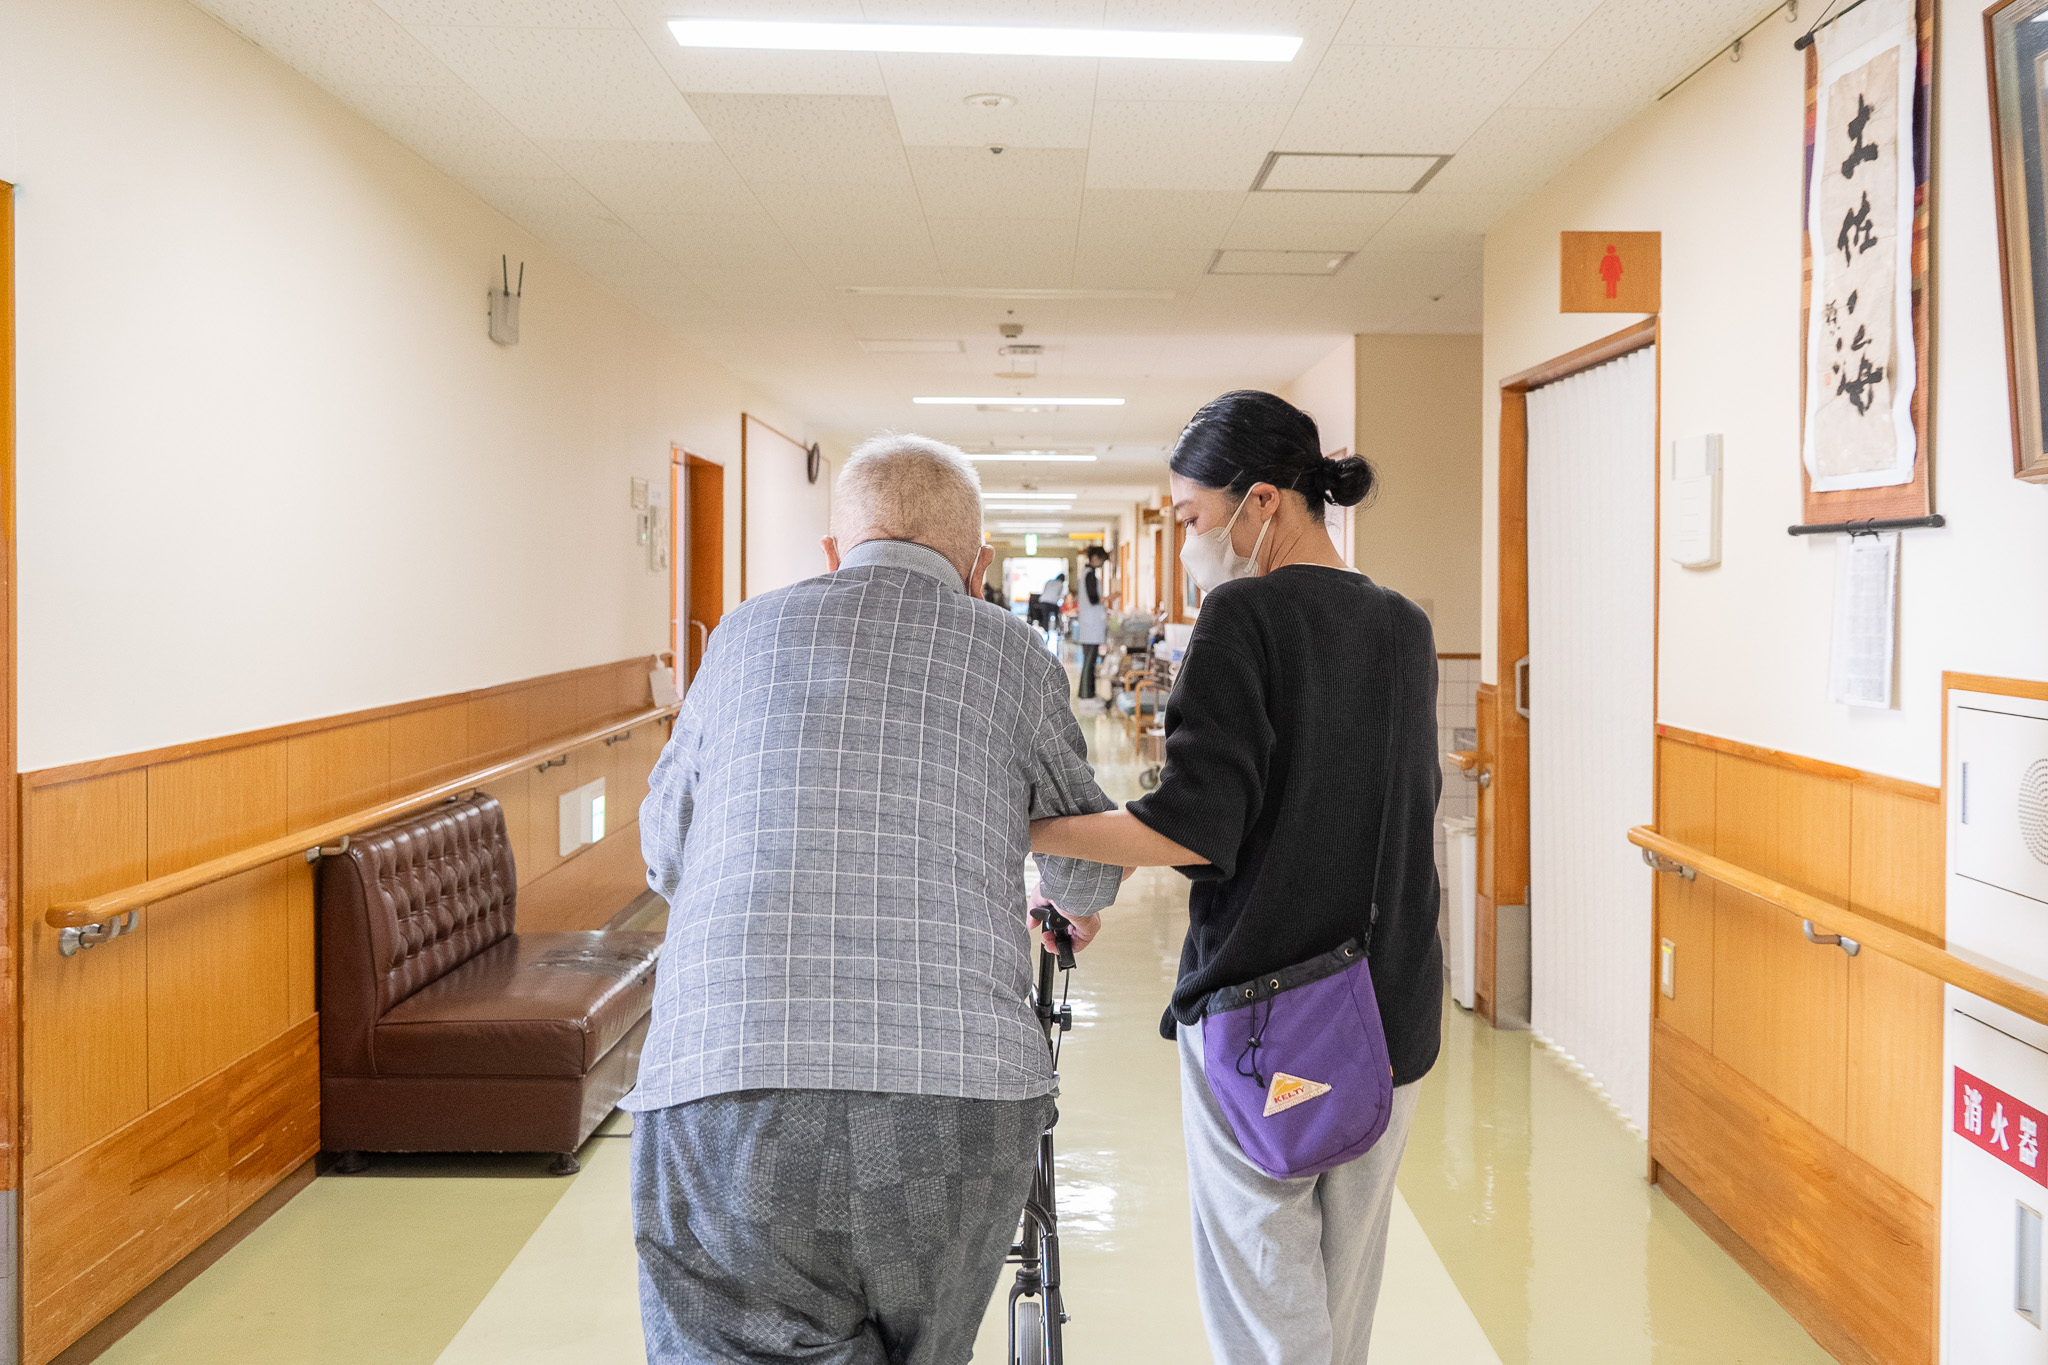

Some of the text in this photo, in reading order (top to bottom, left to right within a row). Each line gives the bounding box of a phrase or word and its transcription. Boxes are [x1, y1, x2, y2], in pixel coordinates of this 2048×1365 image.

[1273, 1085, 1305, 1104] KELTY
[1963, 1084, 2039, 1168] 消火器
